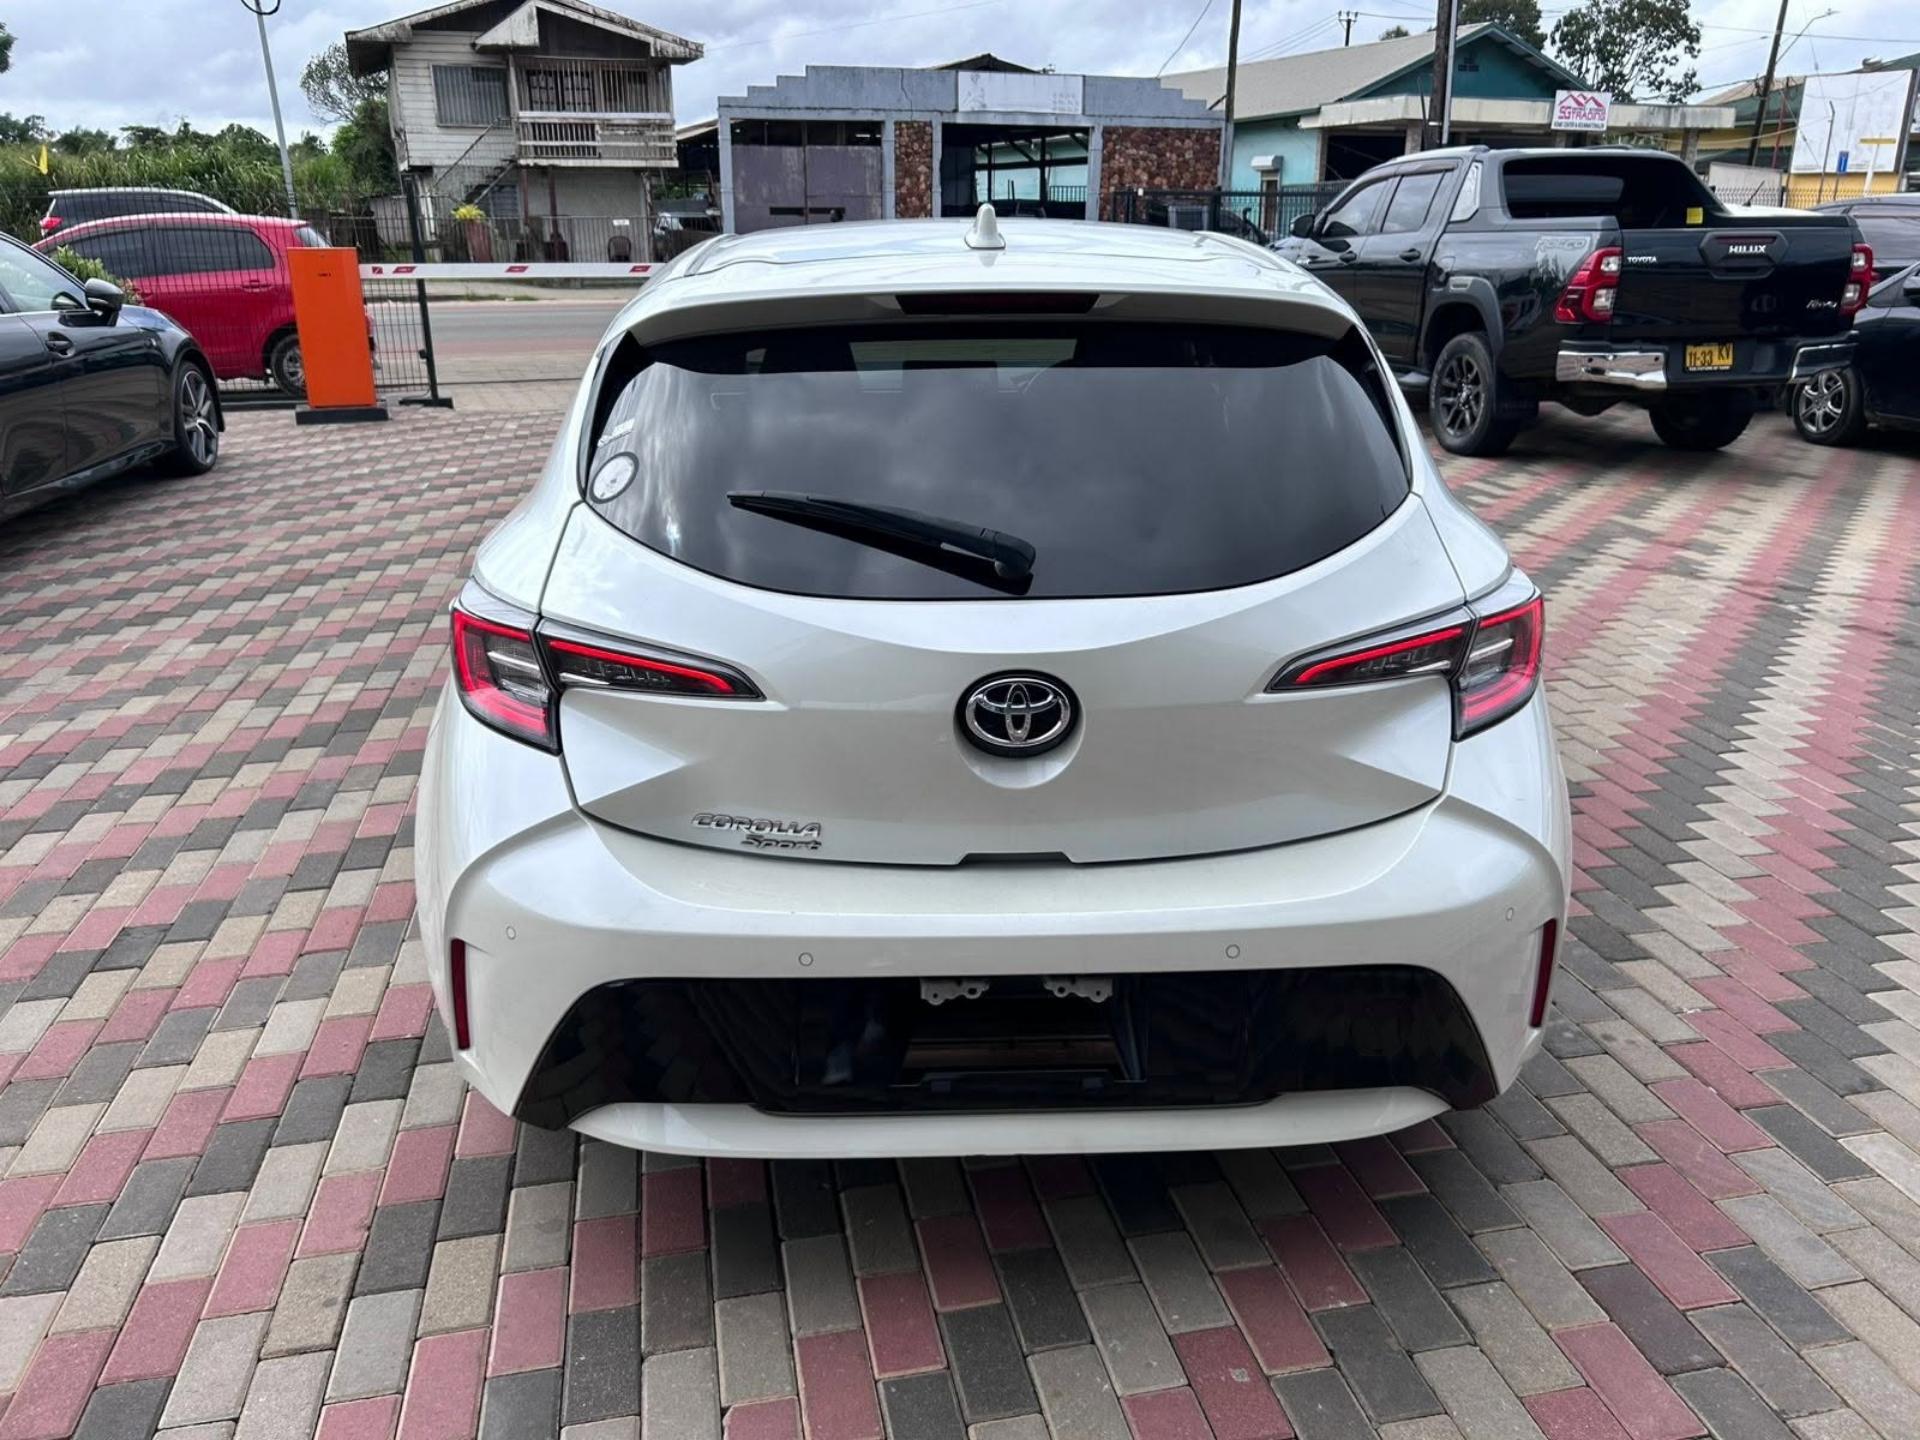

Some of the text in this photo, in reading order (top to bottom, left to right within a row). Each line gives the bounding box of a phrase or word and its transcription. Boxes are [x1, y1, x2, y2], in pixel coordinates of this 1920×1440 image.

[1728, 245, 1767, 254] HILUX
[691, 813, 822, 837] COROLLA
[741, 834, 822, 850] Sport
